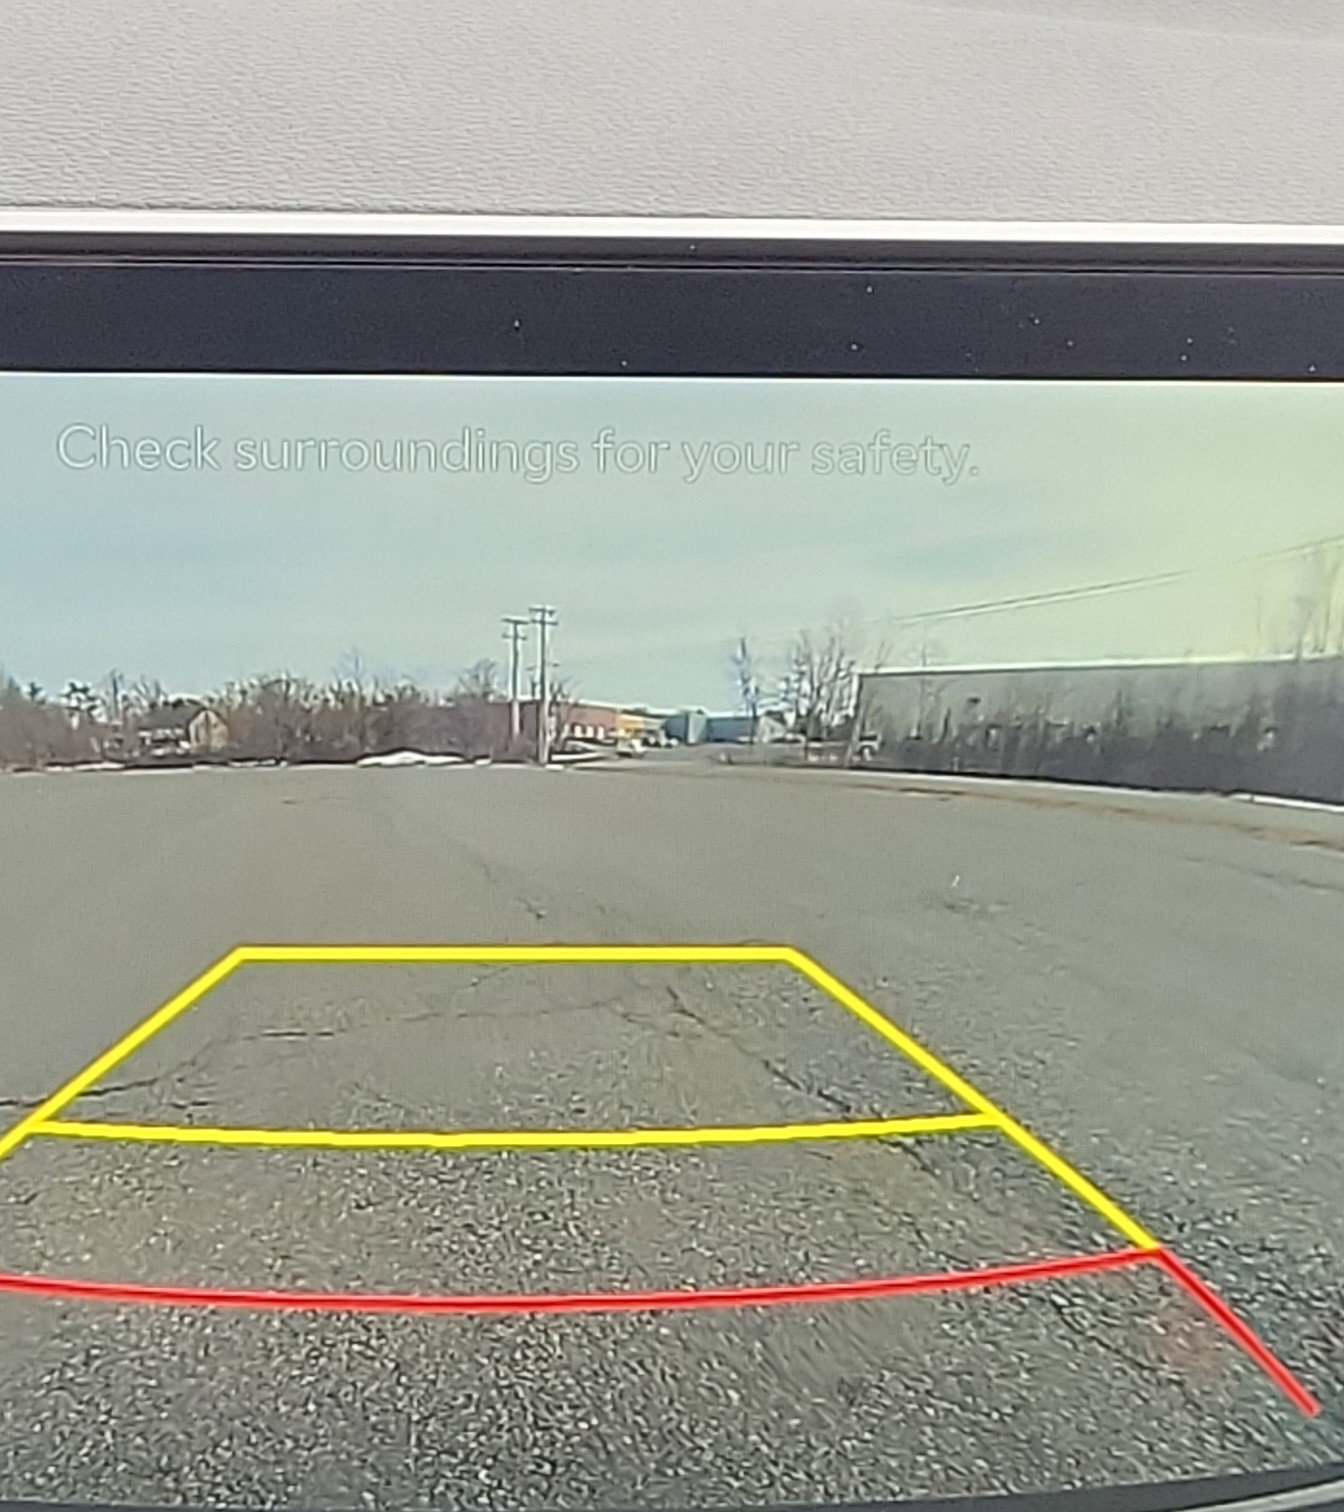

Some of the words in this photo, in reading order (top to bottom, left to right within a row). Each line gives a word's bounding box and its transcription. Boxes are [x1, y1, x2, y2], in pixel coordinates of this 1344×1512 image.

[56, 423, 220, 471] Check
[233, 425, 578, 482] surroundings
[592, 428, 669, 473] for
[681, 439, 800, 484] your
[811, 431, 979, 485] safety.
